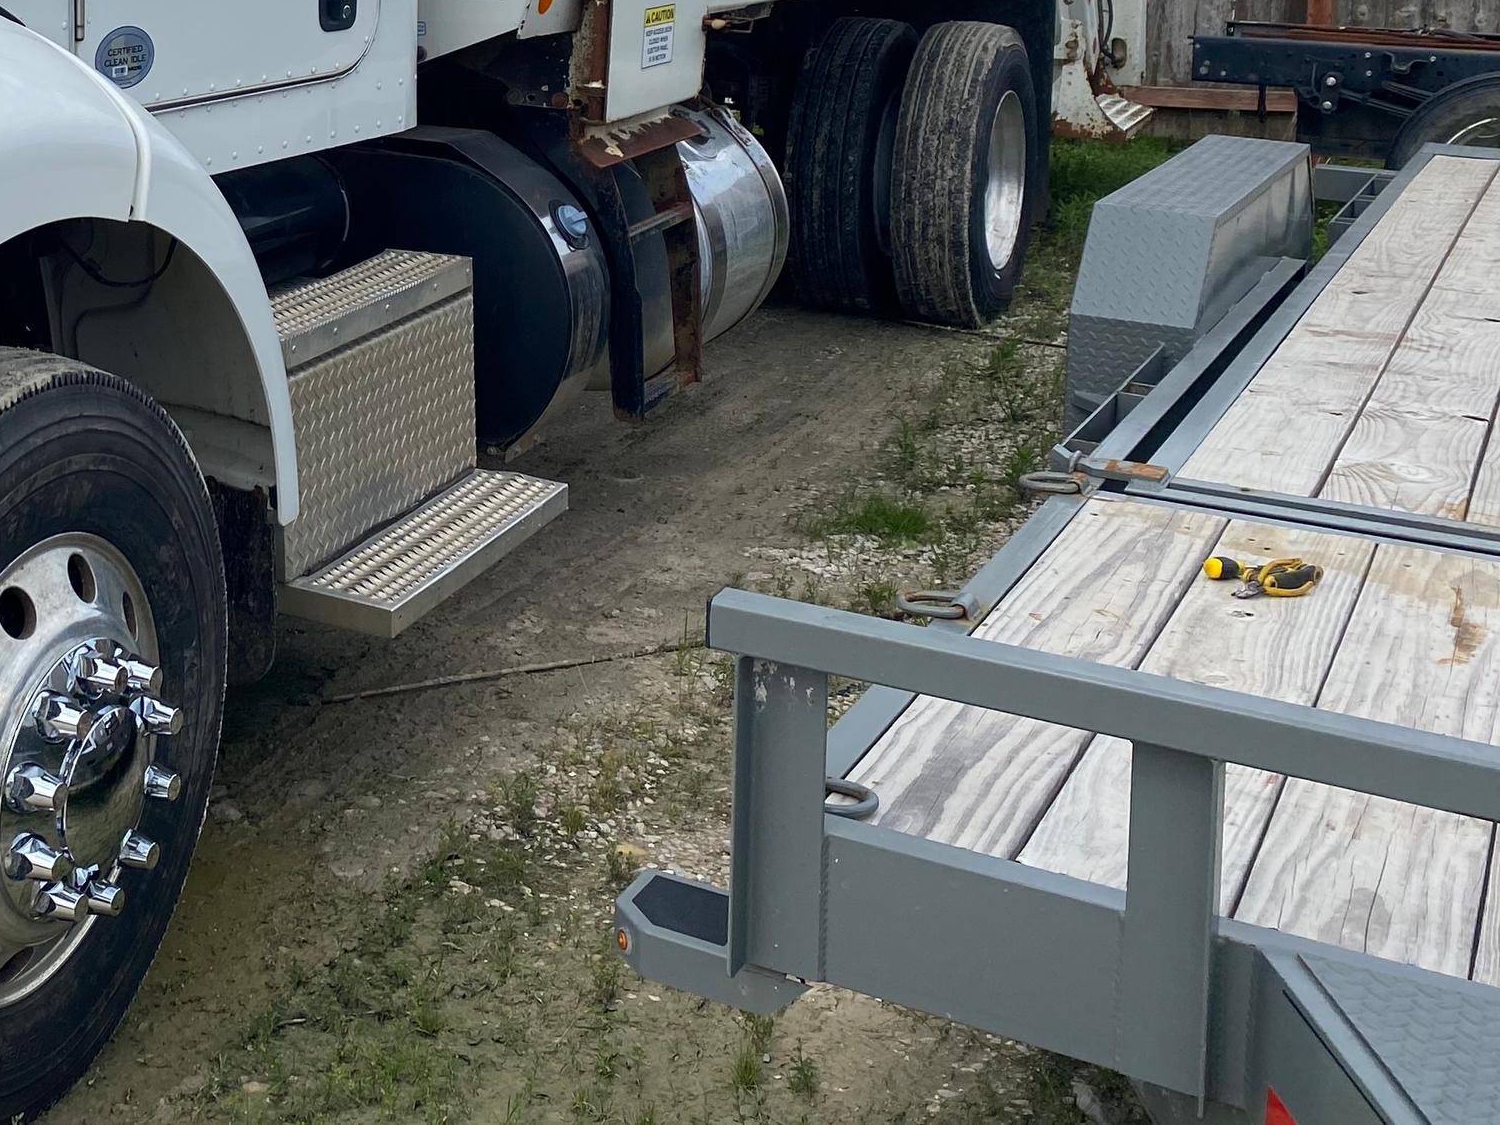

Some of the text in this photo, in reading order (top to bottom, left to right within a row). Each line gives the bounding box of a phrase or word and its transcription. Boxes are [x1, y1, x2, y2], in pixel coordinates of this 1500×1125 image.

[651, 8, 675, 23] CAUTION
[107, 45, 143, 57] CERTIFIED
[104, 57, 128, 68] CLEAN
[131, 53, 147, 63] IDLE
